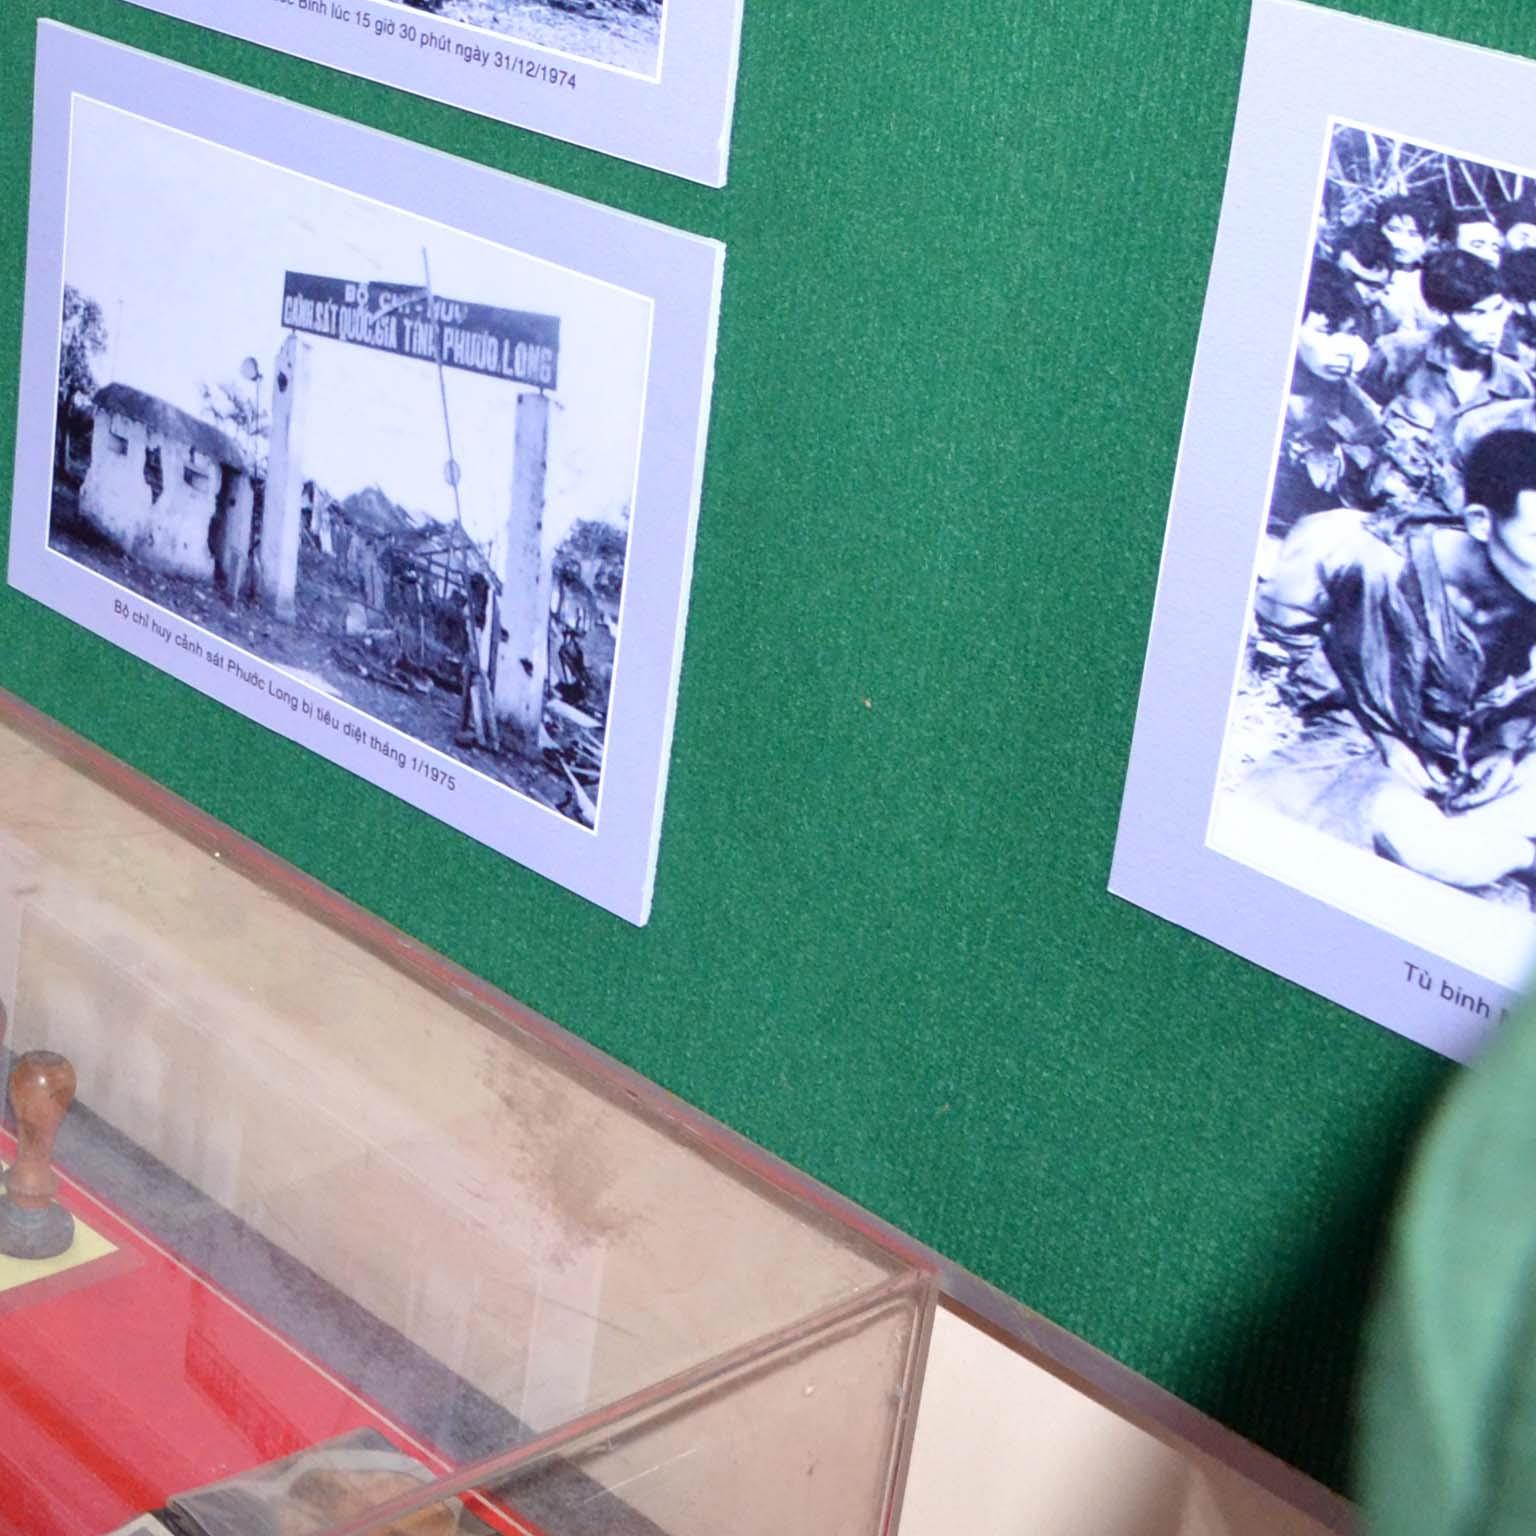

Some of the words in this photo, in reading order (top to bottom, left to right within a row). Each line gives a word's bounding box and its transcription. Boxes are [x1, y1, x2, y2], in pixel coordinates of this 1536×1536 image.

[331, 3, 351, 22] lúc
[355, 10, 371, 28] 15
[374, 17, 395, 36] giờ
[399, 23, 416, 42] 30
[420, 32, 452, 53] phút
[455, 42, 490, 67] ngày
[493, 51, 577, 90] 31/12/1974
[114, 599, 129, 619] Bộ
[132, 610, 148, 627] chỉ
[152, 620, 172, 643] huy
[175, 633, 203, 657] cảnh
[206, 648, 224, 668] sát
[227, 659, 265, 690] Phước
[268, 679, 299, 712] Long
[302, 697, 313, 718] bị
[316, 707, 339, 729] tiêu
[343, 721, 367, 745] diệt
[369, 736, 406, 768] tháng
[410, 757, 457, 792] 1/1975
[1403, 960, 1431, 991] Tù
[1440, 979, 1491, 1019] binh
